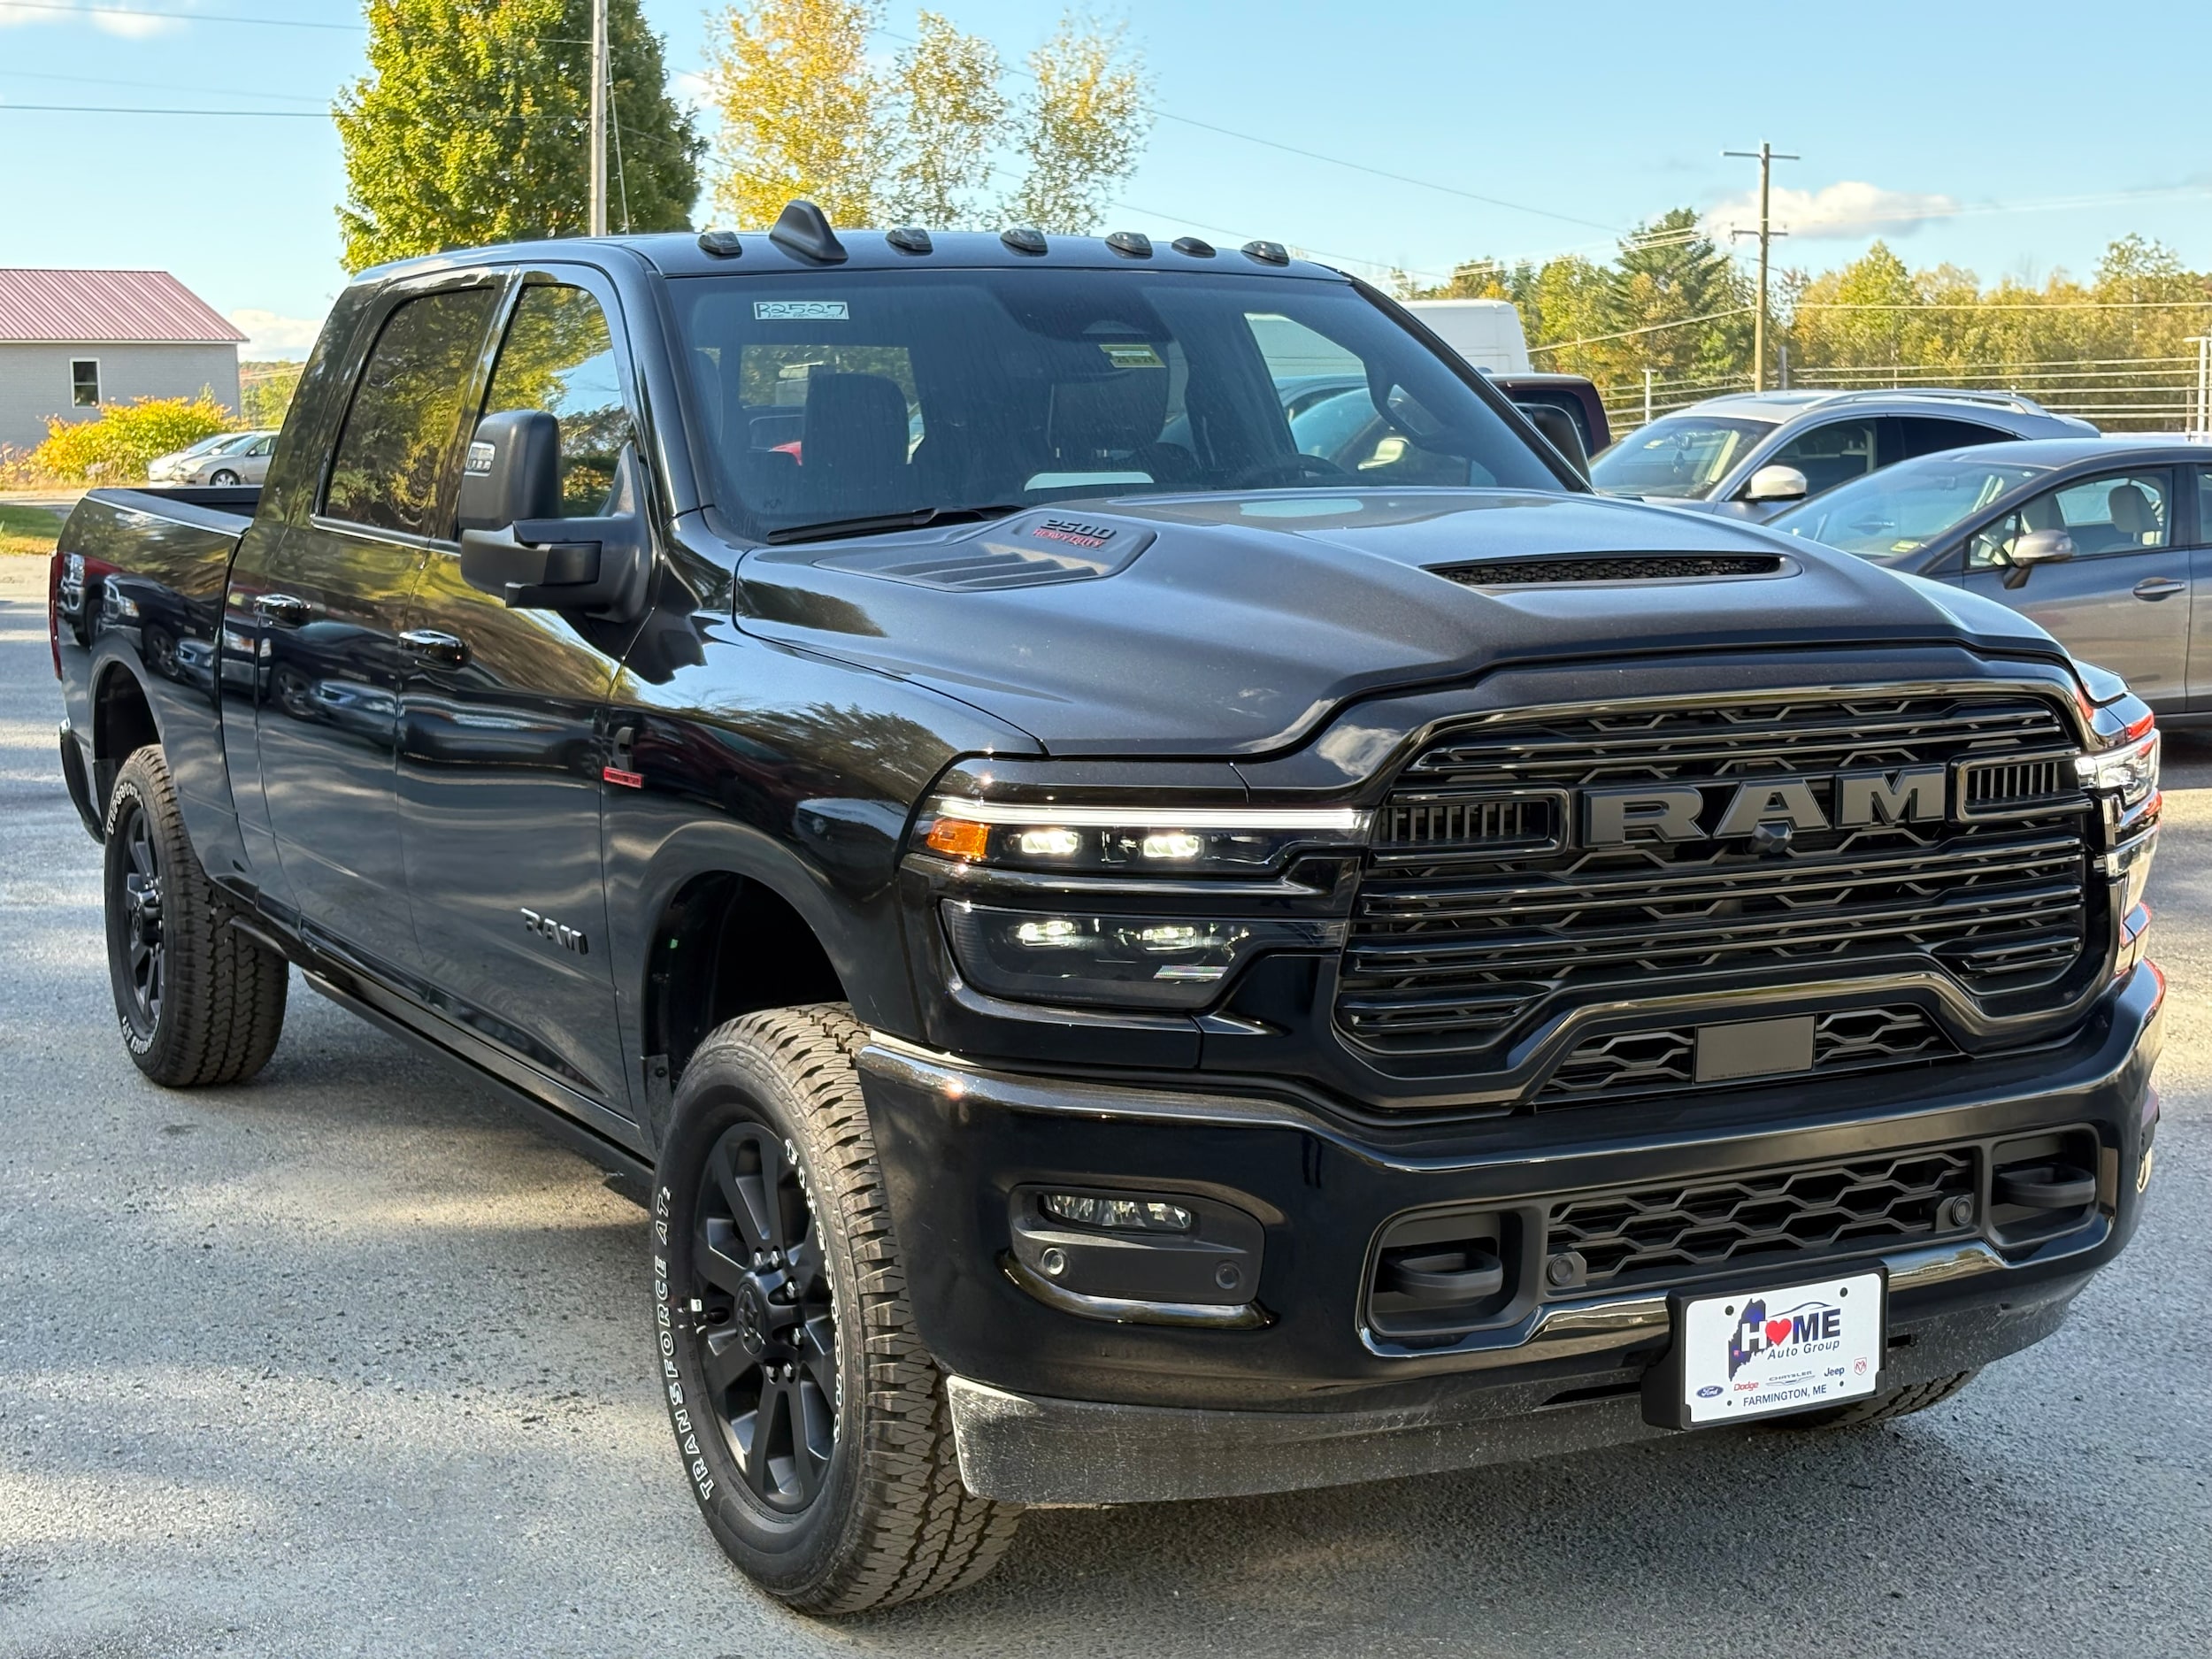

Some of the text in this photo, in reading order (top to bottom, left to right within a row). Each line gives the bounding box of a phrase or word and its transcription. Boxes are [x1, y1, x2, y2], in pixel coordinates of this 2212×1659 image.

[756, 303, 846, 319] R2527
[1033, 528, 1105, 549] HEAVY DUTY
[1040, 518, 1117, 540] 2500
[1583, 766, 1947, 849] RAM
[520, 907, 589, 955] RAM
[1767, 1339, 1840, 1360] Auto Group
[656, 1256, 715, 1501] TRANSFORCE
[1769, 1370, 1813, 1382] CHRYSLER
[1824, 1366, 1845, 1379] Jeep
[1733, 1380, 1760, 1392] Dodge
[1742, 1384, 1828, 1407] FARMINGTON, ME
